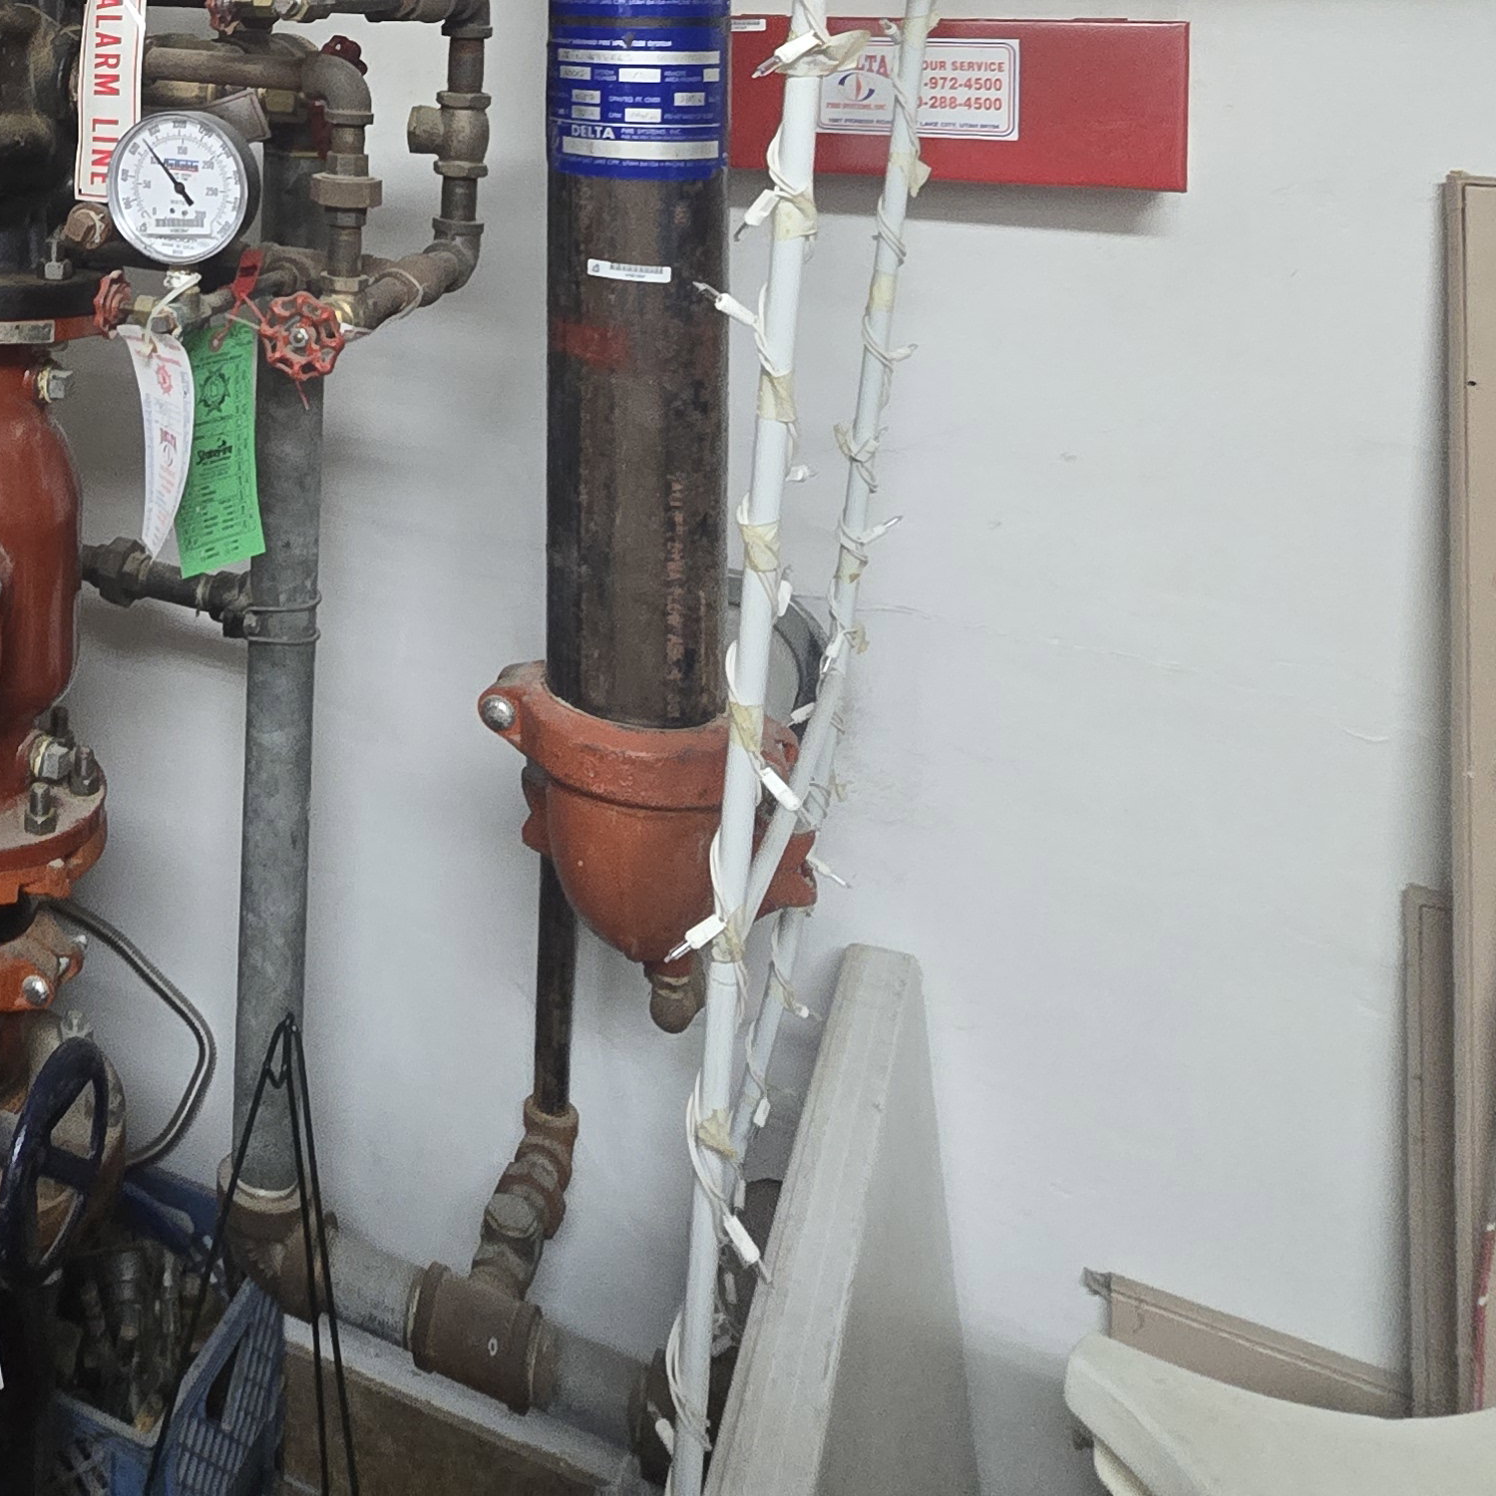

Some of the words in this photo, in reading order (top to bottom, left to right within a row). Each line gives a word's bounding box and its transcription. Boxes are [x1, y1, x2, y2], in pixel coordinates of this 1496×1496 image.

[856, 55, 890, 78] LTA
[922, 60, 946, 70] OUR
[951, 61, 1005, 73] SERVICE
[923, 77, 1003, 91] -972-4500
[919, 96, 1003, 111] -288-4500
[571, 125, 615, 140] DELTA
[90, 118, 119, 186] LINE
